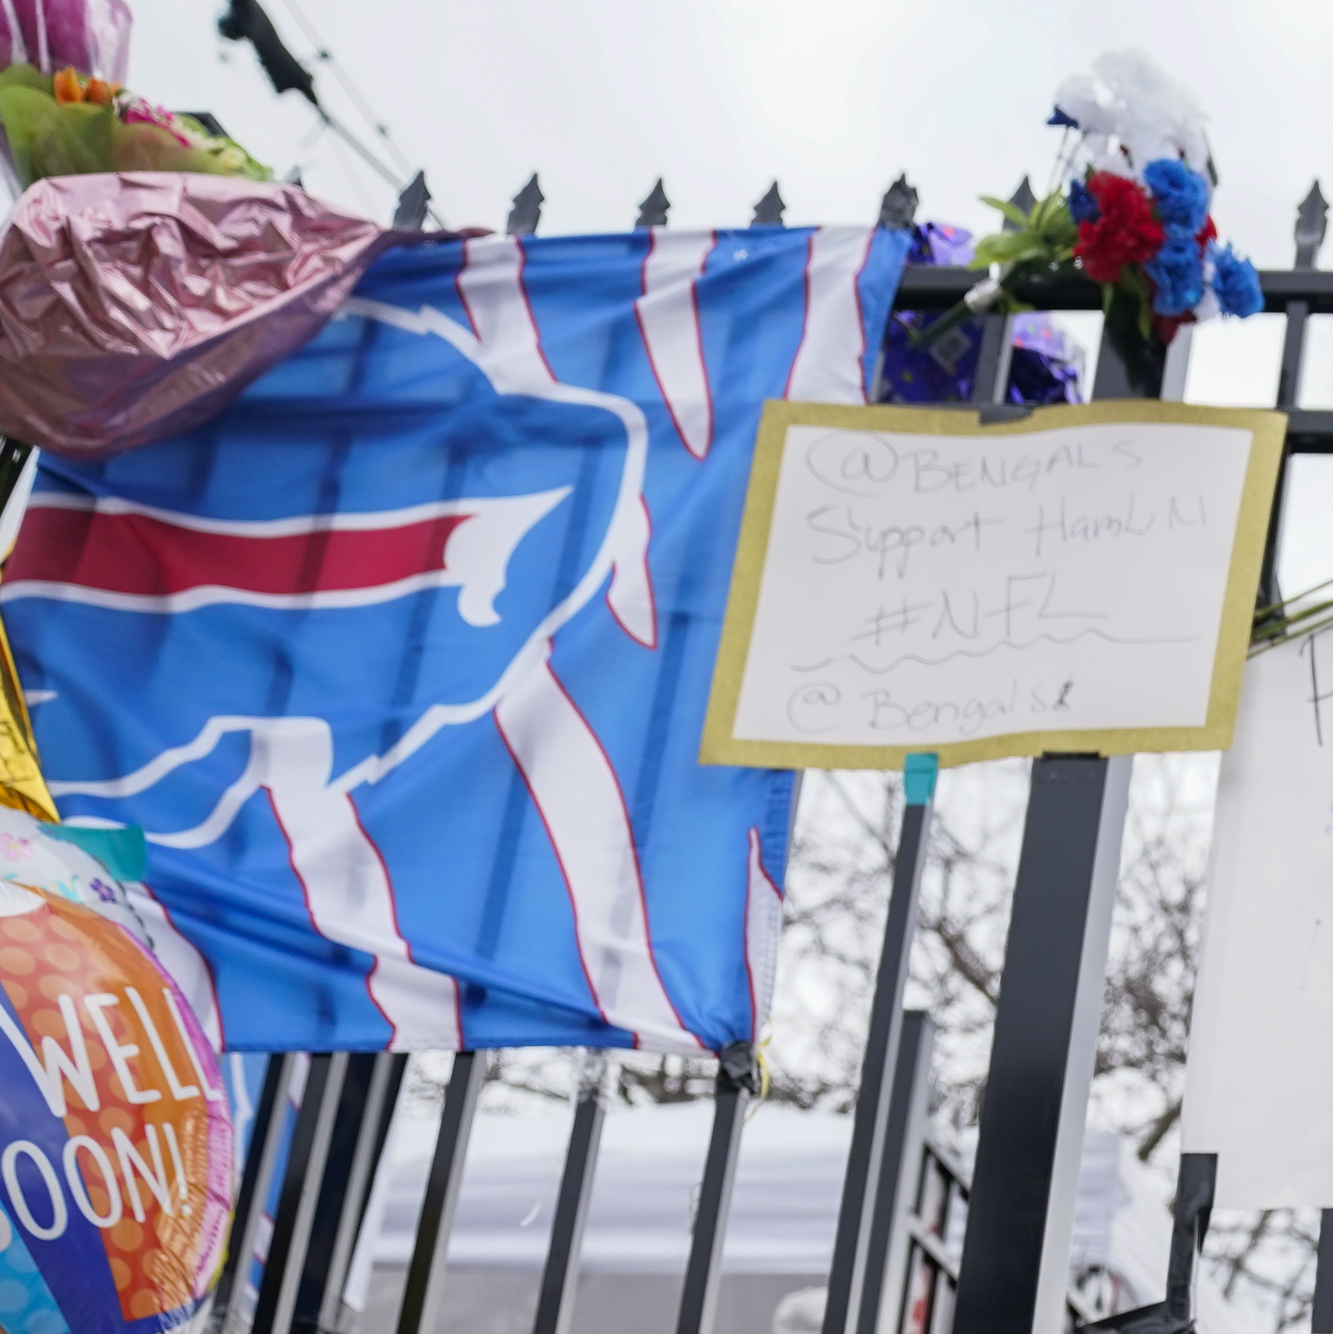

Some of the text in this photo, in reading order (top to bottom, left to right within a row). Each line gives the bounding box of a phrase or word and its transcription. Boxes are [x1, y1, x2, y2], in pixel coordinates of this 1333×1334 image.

[805, 502, 1005, 580] Support
[850, 568, 1110, 646] #NFL
[0, 984, 222, 1118] WELL
